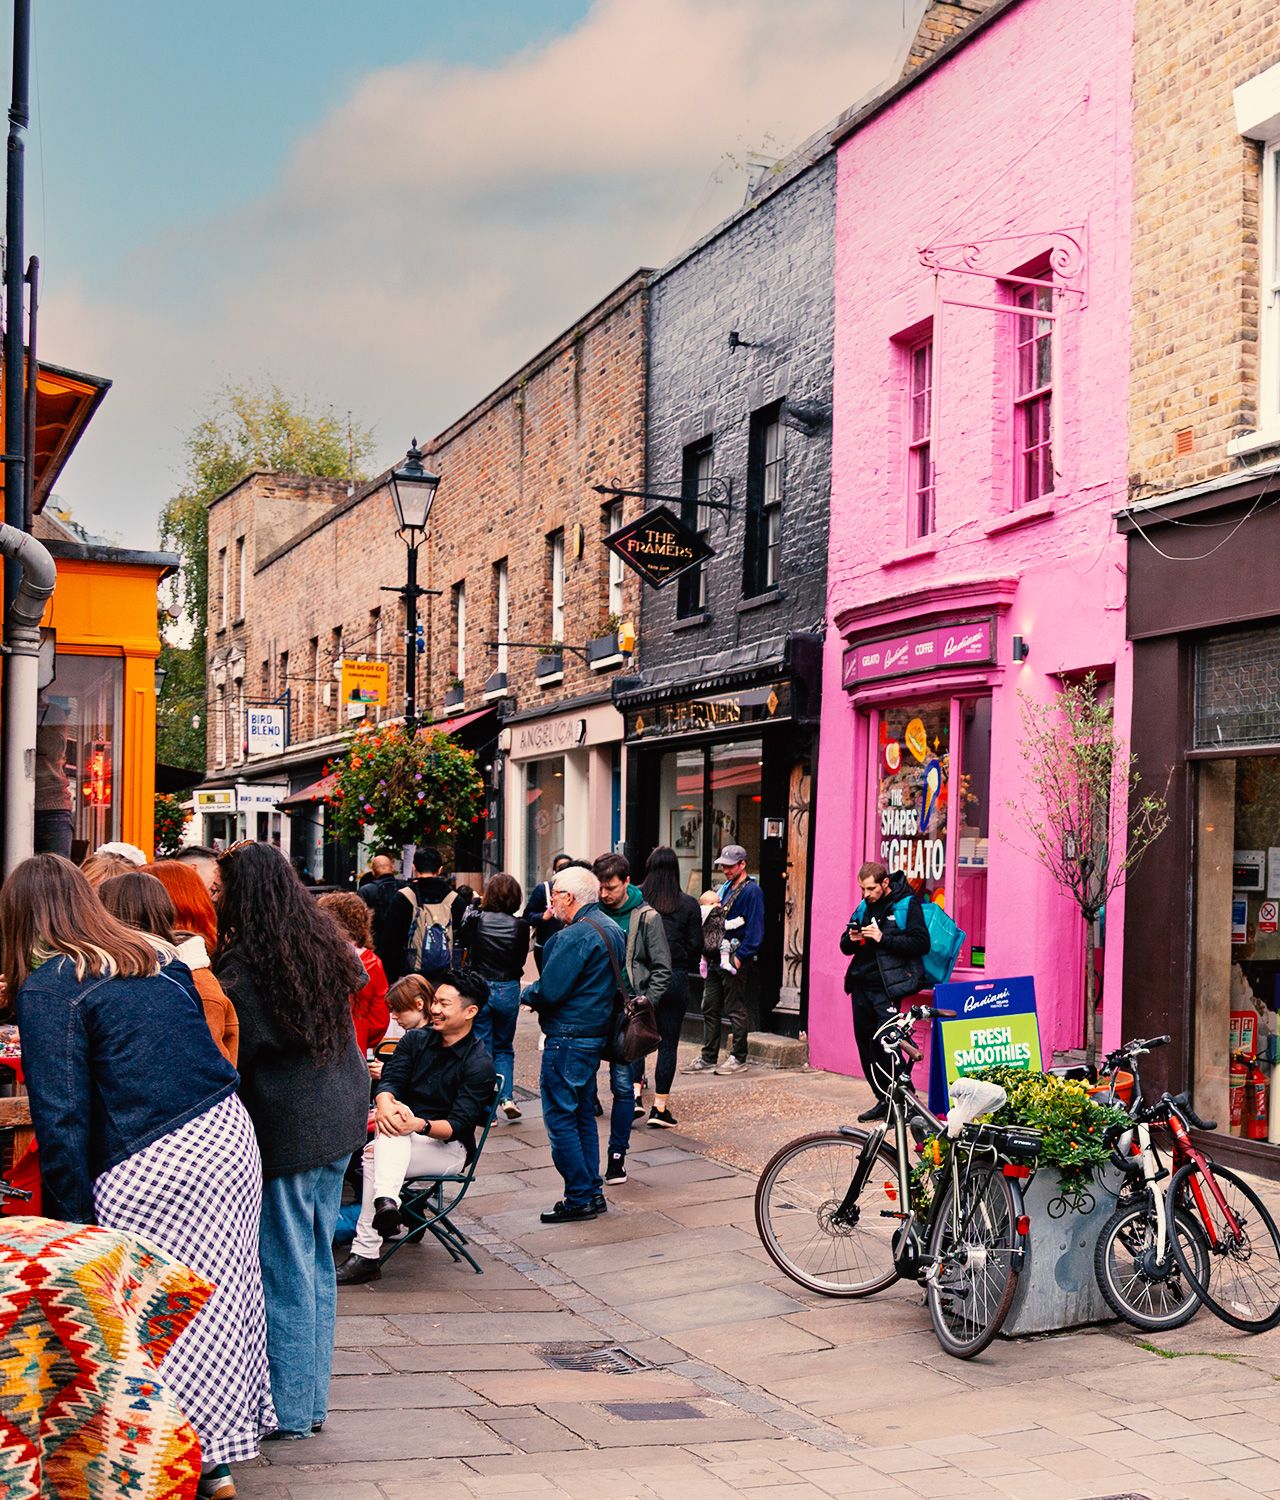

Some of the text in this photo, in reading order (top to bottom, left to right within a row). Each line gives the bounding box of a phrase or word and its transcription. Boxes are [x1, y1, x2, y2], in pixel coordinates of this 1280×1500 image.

[627, 539, 693, 558] FRAMERS
[645, 530, 676, 545] THE
[862, 653, 880, 667] GELATO
[914, 642, 934, 656] COFFEE
[251, 714, 273, 725] BIRD
[690, 698, 741, 728] FRAMERS
[251, 725, 280, 736] BLEND
[891, 789, 902, 806] THE
[881, 809, 918, 836] SHAPES
[881, 839, 944, 880] OF GELATO
[964, 988, 1010, 1013] Badiani
[970, 1026, 1012, 1047] FRESH
[954, 1042, 1031, 1067] SMOOTHIES
